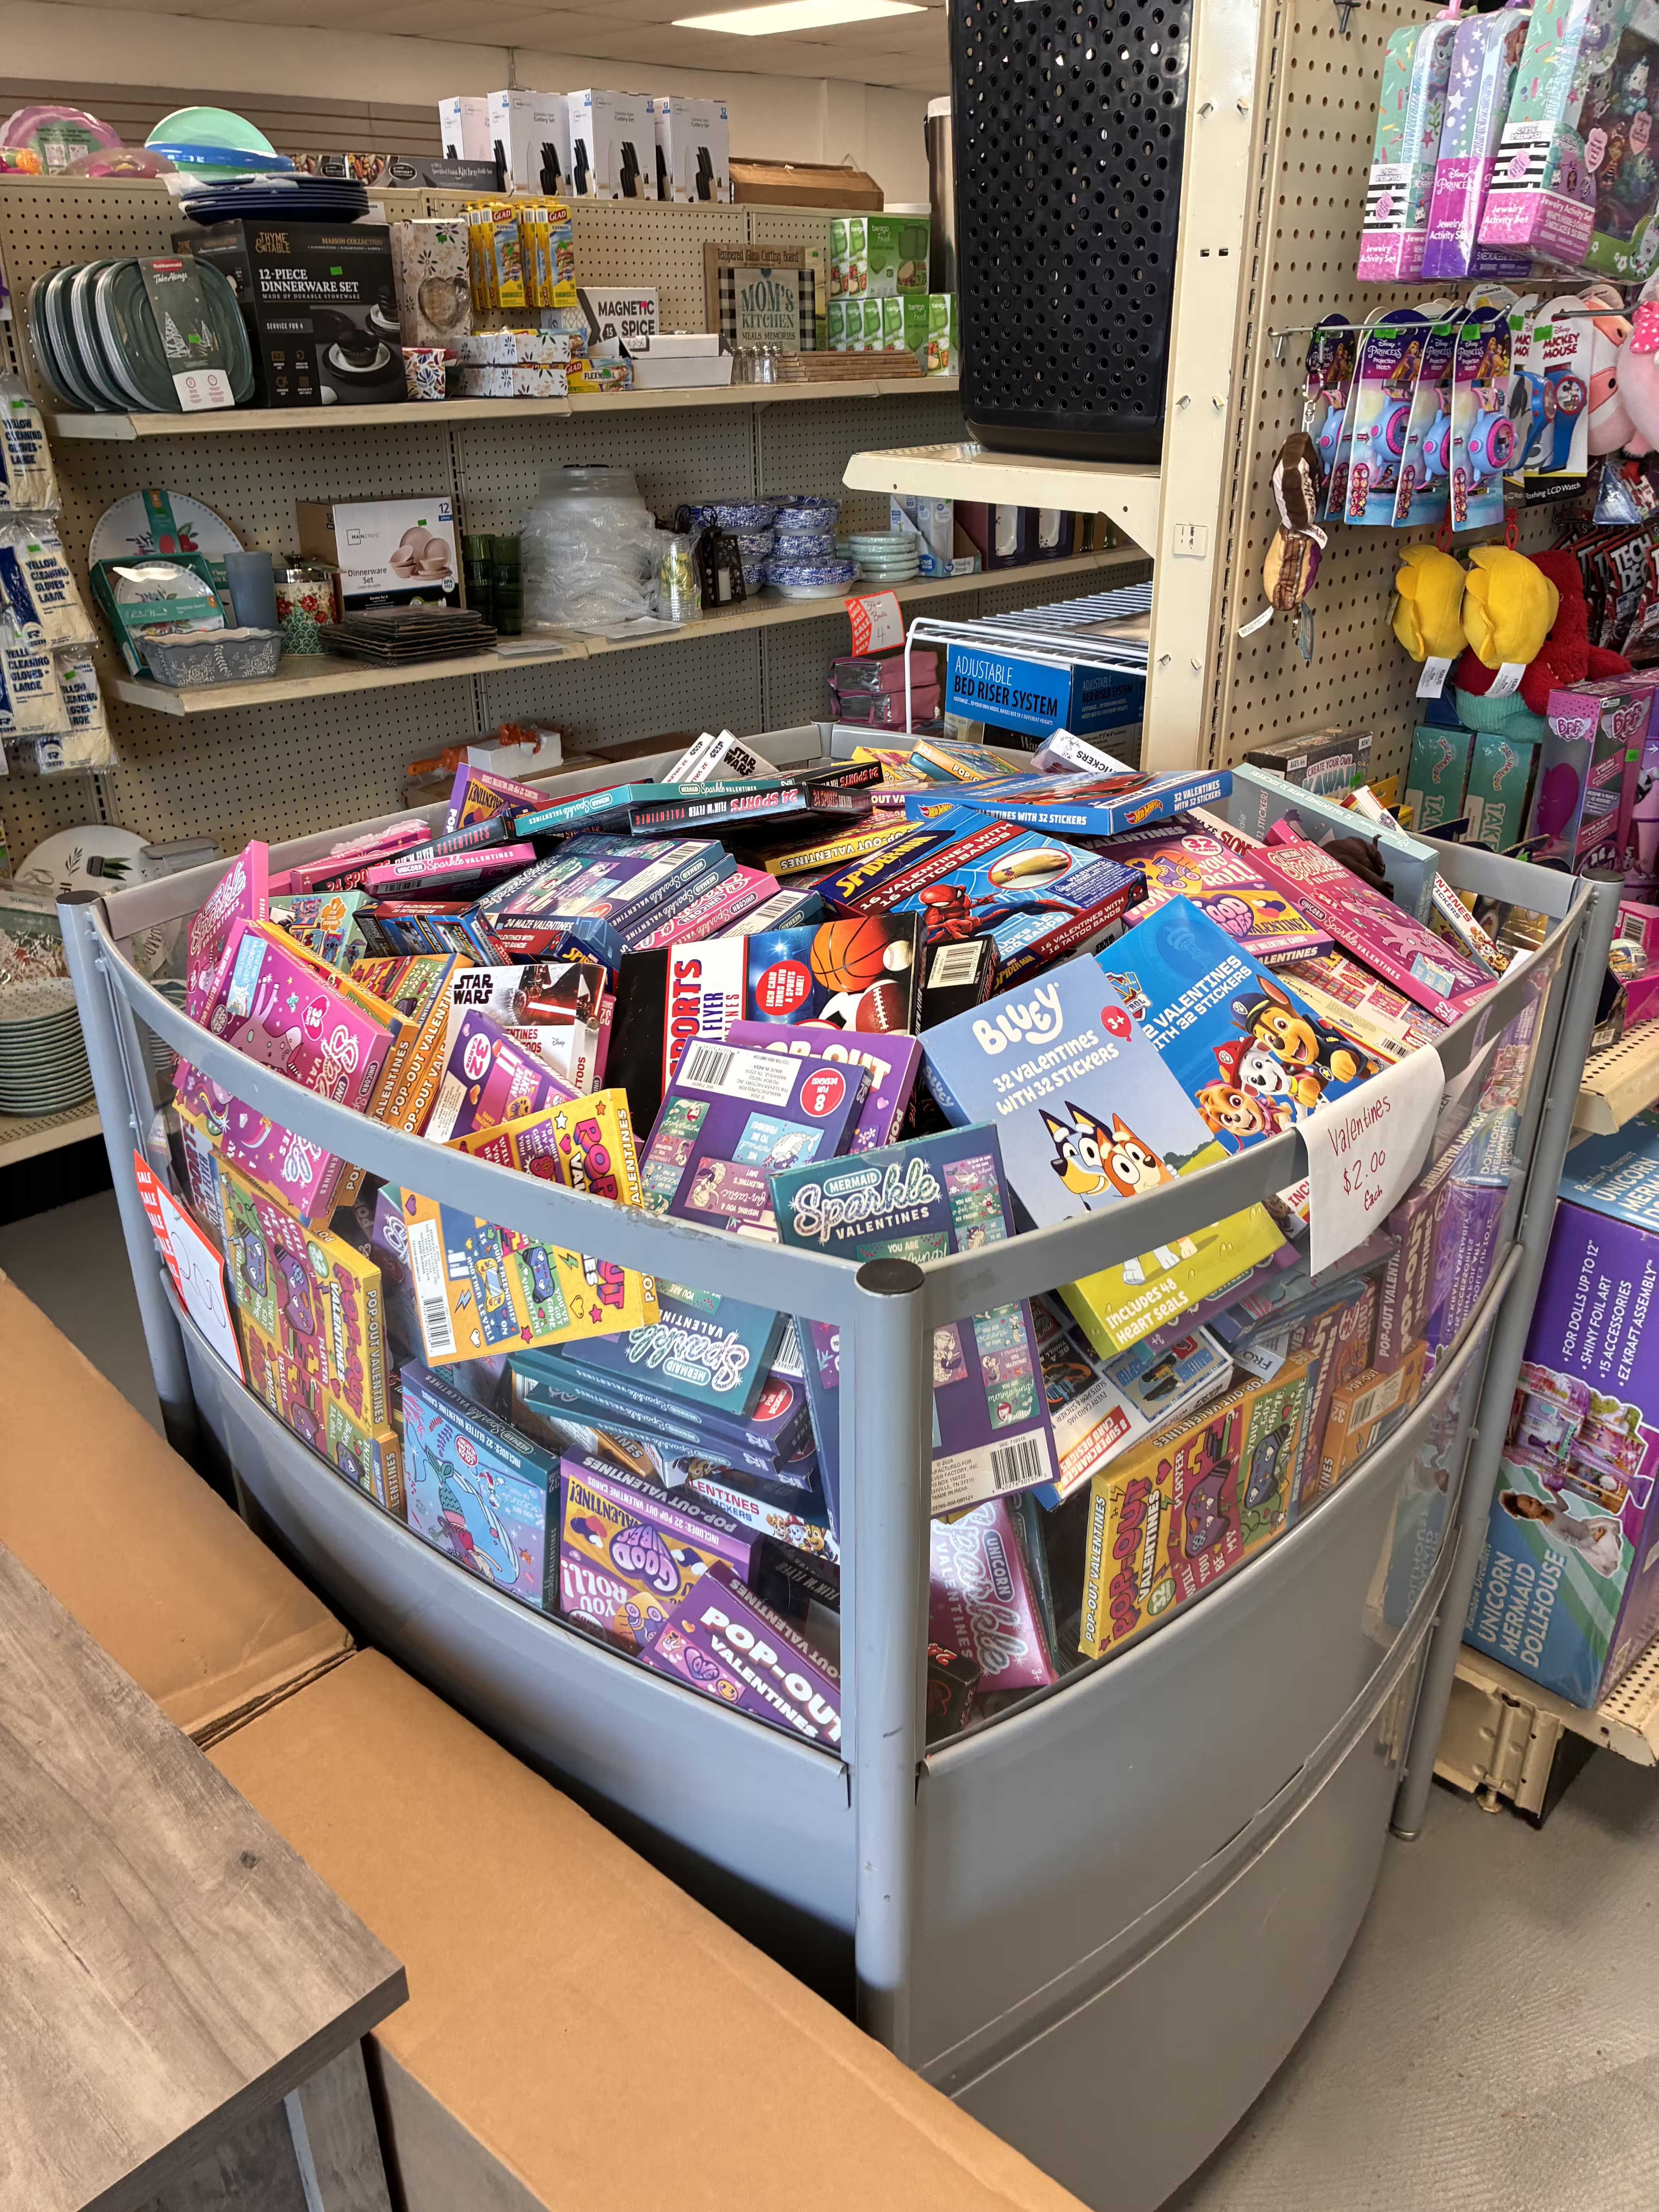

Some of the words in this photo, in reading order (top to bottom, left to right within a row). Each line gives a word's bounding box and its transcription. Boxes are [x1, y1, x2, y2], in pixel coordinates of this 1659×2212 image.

[493, 210, 511, 221] GLAD
[549, 210, 566, 221] GLAD
[1437, 220, 1462, 229] Jewelry
[259, 233, 288, 244] THYME
[1429, 231, 1454, 241] Activity
[718, 249, 744, 263] Tempered
[1360, 254, 1383, 264] Activity
[259, 269, 307, 280] 12-PIECE
[261, 282, 338, 292] DINNERWARE
[340, 282, 358, 292] SET
[741, 281, 794, 312] MOM'S
[598, 301, 654, 316] MAGNETIC
[622, 320, 655, 336] SPICE
[741, 314, 794, 328] KITCHEN
[1543, 332, 1580, 349] MICKEY
[1368, 345, 1401, 359] PRINCESS
[1542, 343, 1577, 359] MOUSE
[439, 503, 450, 514] 12
[1611, 534, 1651, 574] TECH
[348, 568, 387, 577] Dinnerware
[854, 619, 871, 637] SALE
[955, 656, 1013, 686] ADJUSTABLE
[1082, 675, 1111, 690] ADJUSTABLE
[954, 675, 975, 696] BED
[977, 681, 1008, 705] RISER
[1012, 689, 1057, 717] SYSTEM
[1558, 718, 1583, 735] BFF
[1308, 763, 1324, 777] CREATE
[1326, 757, 1339, 769] YOUR
[1340, 755, 1352, 765] OWN
[700, 782, 725, 795] Sparkle
[782, 789, 798, 803] 24
[1174, 793, 1182, 802] 32
[1183, 780, 1219, 799] VALENTINES
[689, 804, 705, 817] FLYER
[730, 793, 779, 813] SPORTS
[635, 809, 685, 825] VALENTINES
[1015, 812, 1036, 821] WITH
[1038, 813, 1048, 822] 32
[1050, 814, 1087, 825] STICKERS
[1185, 838, 1212, 849] 32
[397, 864, 424, 873] UNICORN
[427, 856, 464, 871] Sparkle
[465, 850, 514, 864] VALENTINES
[780, 844, 855, 870] VALENTINES
[835, 835, 938, 898] SPIDER-MAN
[859, 896, 881, 910] 16
[883, 841, 972, 897] VALENTINES
[973, 823, 1013, 843] WITH
[1200, 857, 1227, 874] YOU
[1202, 860, 1263, 886] ROLL!
[505, 919, 518, 928] 24
[518, 919, 534, 929] MAZE
[533, 920, 574, 931] VALENTINES
[1300, 897, 1325, 921] UNICORN
[1324, 915, 1358, 950] Sparkle
[1357, 943, 1401, 981] VALENTINES
[458, 974, 493, 989] STAR
[766, 972, 776, 987] CARD
[776, 969, 787, 984] INTO
[786, 971, 796, 995] SPORTS
[795, 975, 805, 996] GAME!
[453, 990, 493, 1005] WARS
[765, 988, 775, 1007] EACH
[775, 985, 786, 1007] TURNS
[1179, 1016, 1201, 1039] 32
[1195, 967, 1253, 1017] STICKERS
[702, 992, 724, 1032] FLYER
[1108, 1015, 1125, 1030] 3+
[360, 1063, 378, 1096] UNICORN
[993, 1073, 1012, 1093] 32
[1035, 1077, 1054, 1097] 32
[814, 1094, 826, 1111] 8
[1327, 1096, 1391, 1157] Valentines
[137, 1172, 152, 1185] SALE
[1343, 1150, 1386, 1195] $2.00
[733, 1178, 764, 1189] VALENTINE'S
[829, 1173, 878, 1193] MERMAID
[794, 1158, 940, 1243] Sparkle
[1364, 1188, 1384, 1211] Each
[836, 1207, 929, 1240] VALENTINES
[887, 1242, 903, 1253] YOU
[905, 1240, 920, 1250] ARE
[1589, 1240, 1599, 1259] 12"
[1584, 1258, 1595, 1275] TO
[493, 1243, 502, 1262] OUR
[499, 1266, 517, 1323] FRIENDSHIP
[1160, 1278, 1177, 1295] 48
[1580, 1275, 1589, 1294] UP
[467, 1256, 482, 1298] ANOTHER
[478, 1304, 495, 1341] LEVEL!
[555, 1287, 569, 1323] YOU'VE
[366, 1290, 379, 1338] POP-OUT
[1569, 1297, 1587, 1335] DOLLS
[1582, 1326, 1597, 1365] SHINY
[1593, 1299, 1606, 1326] FOIL
[1600, 1276, 1612, 1299] ART
[1603, 1280, 1632, 1363] ACCESSORIES
[1562, 1336, 1576, 1356] FOR
[1623, 1327, 1640, 1364] KRAFT
[318, 1336, 328, 1384] PLAYER
[1600, 1362, 1610, 1377] 15
[667, 1360, 705, 1381] MERMAID
[1618, 1365, 1631, 1381] EZ
[370, 1340, 384, 1425] VALENTINES
[422, 1390, 438, 1408] CARDS
[1092, 1391, 1107, 1407] EVERY
[438, 1405, 465, 1427] VALENTINE
[1078, 1403, 1092, 1417] CARD
[465, 1422, 485, 1442] GLITTER
[486, 1437, 494, 1448] 32
[495, 1447, 521, 1468] INCLUDES:
[582, 1455, 676, 1505] VALENTINES
[680, 1494, 735, 1533] POP-OUT
[986, 1537, 1011, 1595] UNICORN
[1477, 1551, 1515, 1643] UNICORN
[1499, 1562, 1536, 1656] MERMAID
[1520, 1549, 1567, 1668] DOLLHOUSE
